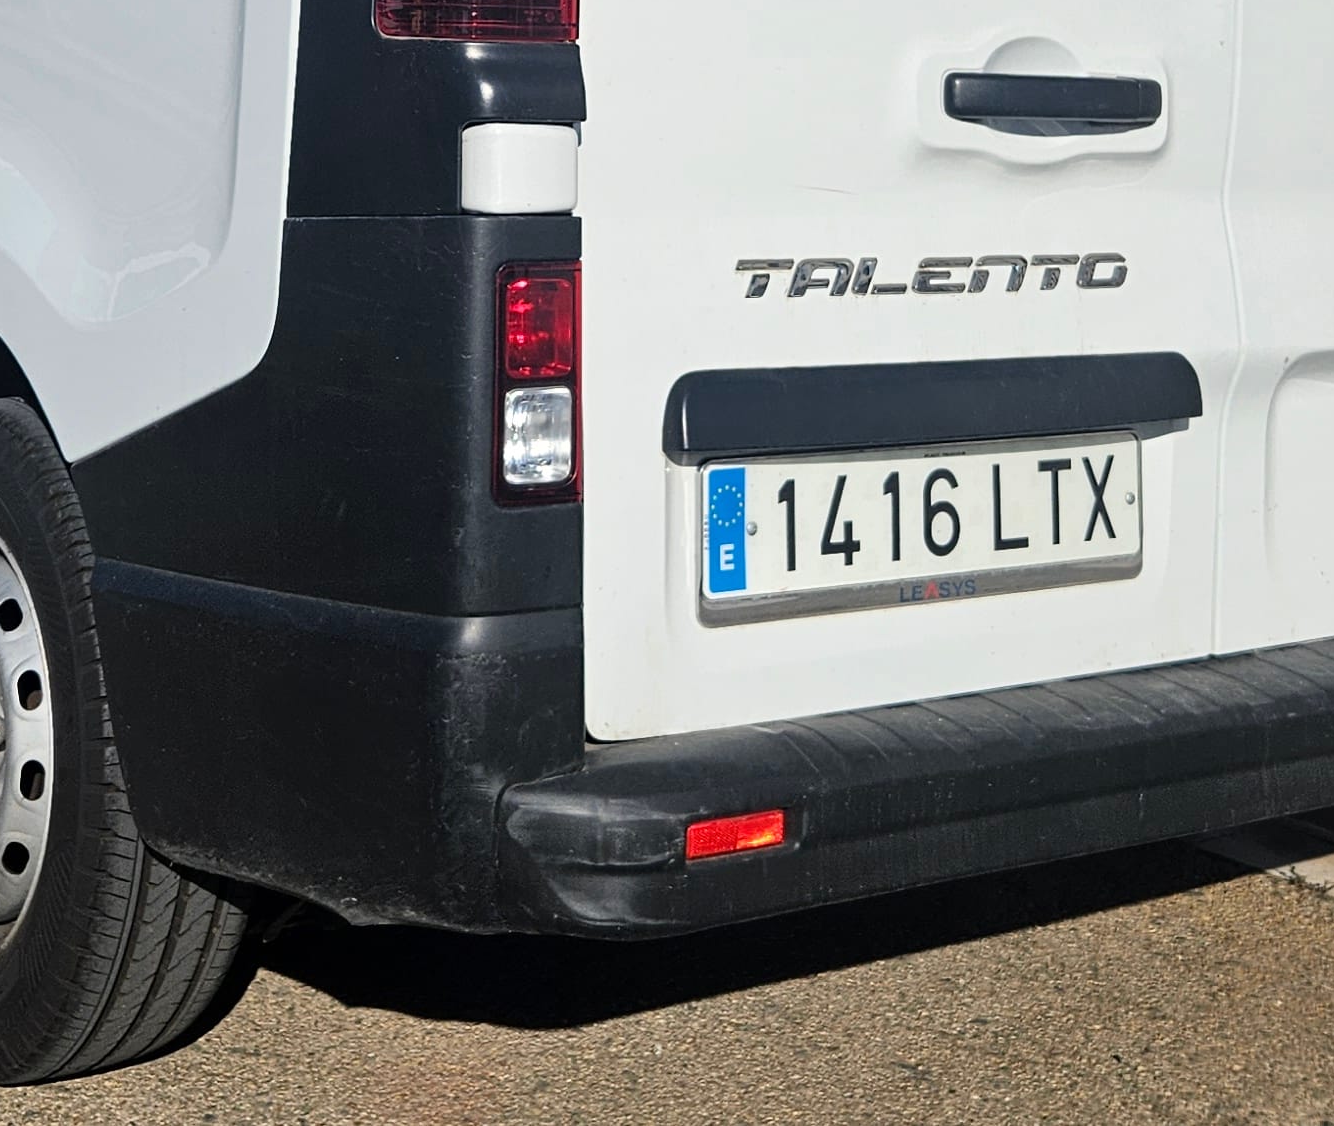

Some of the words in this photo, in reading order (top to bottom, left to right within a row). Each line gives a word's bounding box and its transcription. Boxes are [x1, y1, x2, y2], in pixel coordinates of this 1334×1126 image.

[734, 251, 1129, 299] TALENTO
[777, 467, 961, 572] 1416
[991, 454, 1117, 552] LTX
[719, 543, 736, 571] E
[899, 579, 977, 603] LEASYS
